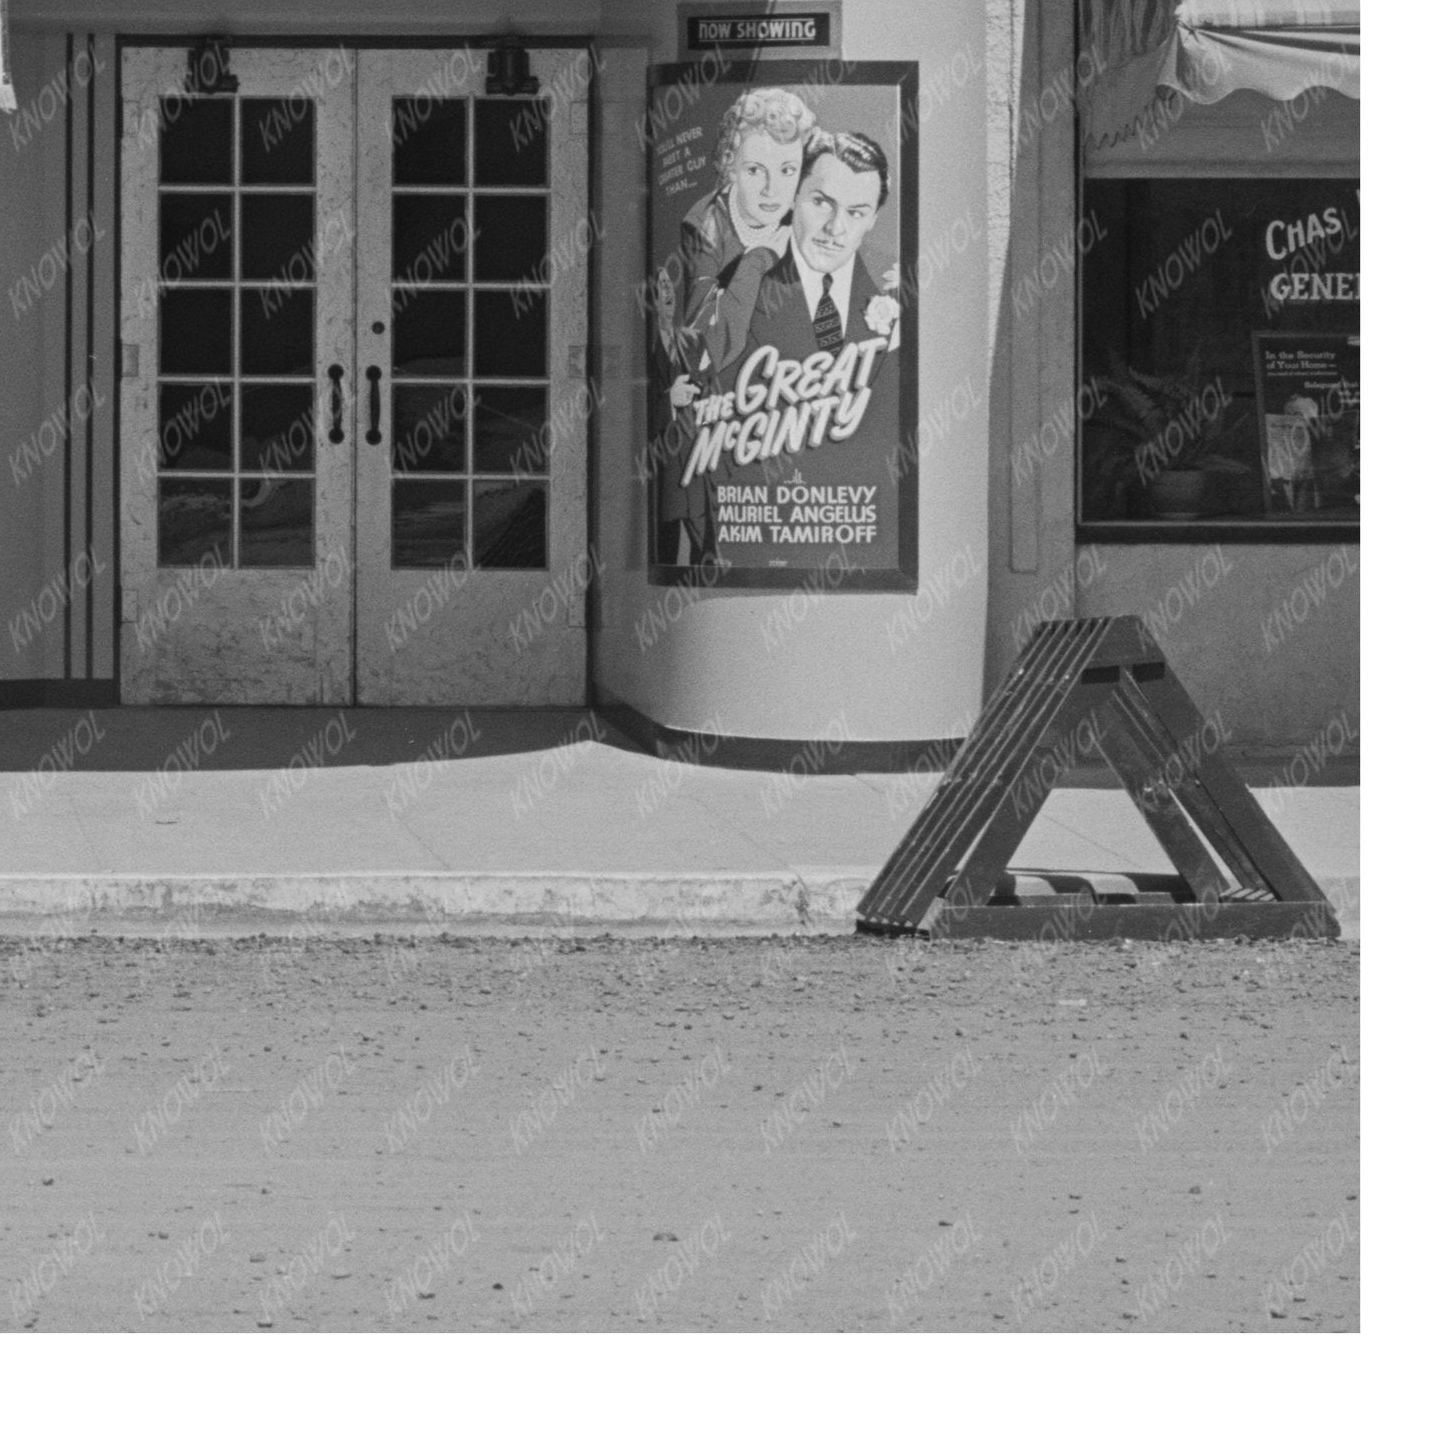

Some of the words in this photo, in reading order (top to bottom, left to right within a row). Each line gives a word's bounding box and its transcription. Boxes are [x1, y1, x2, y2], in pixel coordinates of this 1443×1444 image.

[1266, 207, 1343, 260] CHAS
[1270, 272, 1361, 301] GENE
[693, 391, 736, 426] THE
[735, 337, 889, 415] GREAT
[717, 485, 768, 504] BRIAN
[776, 485, 877, 504] DONLEVY
[717, 505, 783, 523] MURIEL
[790, 504, 877, 523] ANGELUS
[718, 525, 763, 543] AKIM
[769, 524, 878, 543] TAMIROFF
